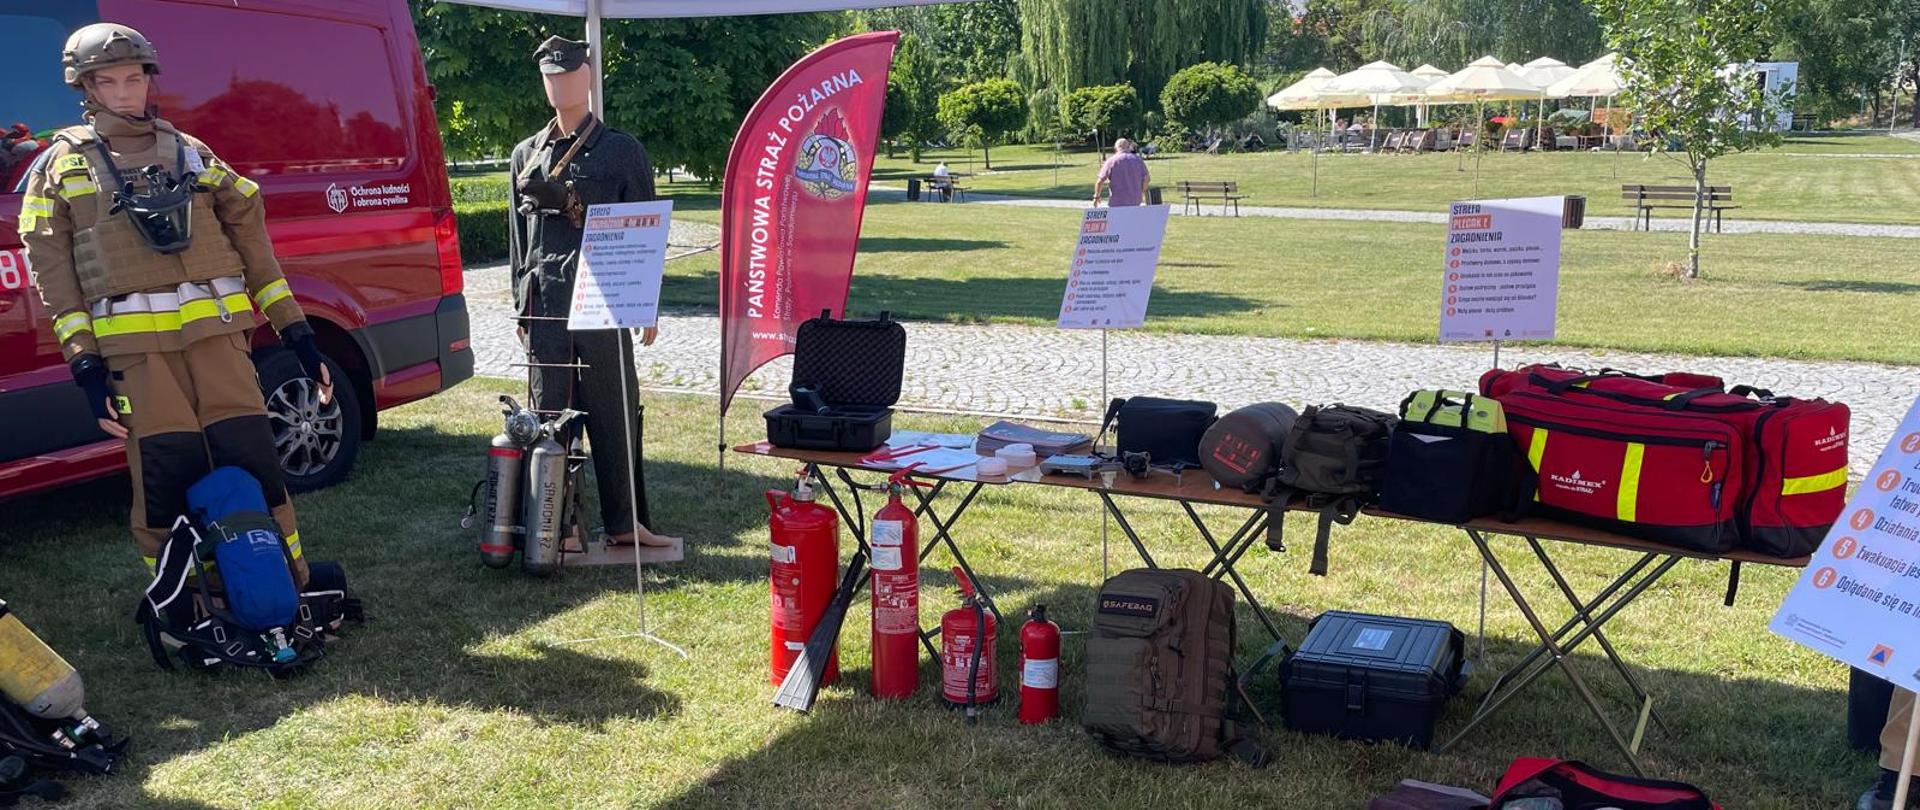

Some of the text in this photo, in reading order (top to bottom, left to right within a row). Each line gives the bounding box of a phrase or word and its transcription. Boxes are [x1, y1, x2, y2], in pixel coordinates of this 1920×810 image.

[778, 69, 863, 133] POŻARNA
[756, 131, 787, 190] STRAŻ
[351, 183, 410, 196] Ochrona ludności
[357, 198, 382, 207] obrona
[383, 195, 409, 206] cywilna
[1453, 204, 1481, 215] STREFA
[1080, 234, 1120, 245] ZAGADNIENIA
[1450, 231, 1503, 244] ZAGADNIENIA
[744, 196, 771, 318] PAŃSTWOWA
[773, 278, 783, 319] Komenda
[1906, 434, 1920, 451] 2
[1882, 472, 1896, 489] 3
[1889, 494, 1918, 514] łatwa
[1874, 516, 1919, 542] Działania
[1838, 540, 1853, 557] 5
[1856, 545, 1907, 573] Ewakuacja
[1818, 569, 1832, 587] 6
[1836, 575, 1883, 603] Oglądanie
[1881, 593, 1900, 612] się
[1898, 600, 1913, 614] na
